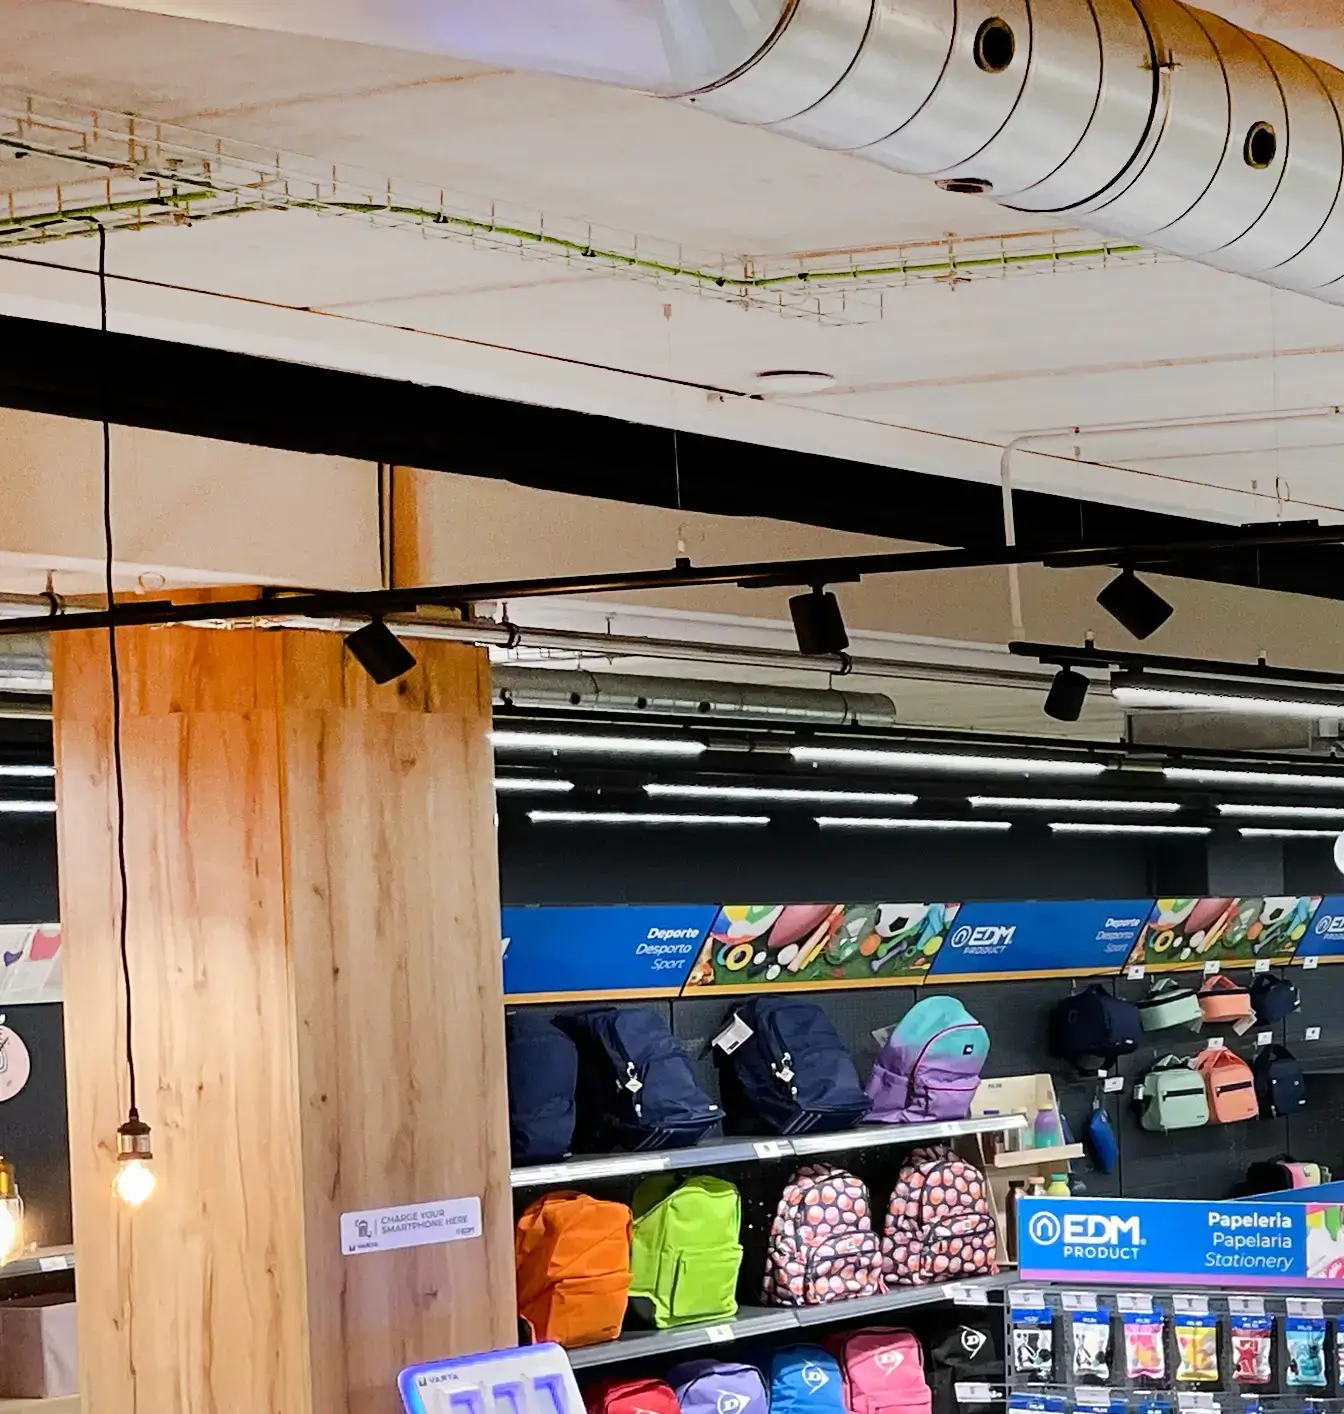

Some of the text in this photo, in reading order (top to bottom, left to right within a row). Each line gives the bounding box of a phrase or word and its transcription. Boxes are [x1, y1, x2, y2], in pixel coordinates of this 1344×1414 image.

[647, 927, 700, 941] Deporte
[969, 925, 1017, 946] EDM
[635, 943, 692, 956] Desporto
[963, 945, 1006, 955] PRODUCT
[650, 958, 686, 971] Sport
[381, 1209, 445, 1225] CHARGE YOUR
[382, 1215, 468, 1234] SMARTPHONE HERE
[1064, 1214, 1140, 1246] EDM
[1213, 1231, 1292, 1251] Papelaria
[1063, 1246, 1140, 1261] PRODUCT
[1204, 1251, 1294, 1272] Stationery
[429, 1374, 459, 1383] VARTA
